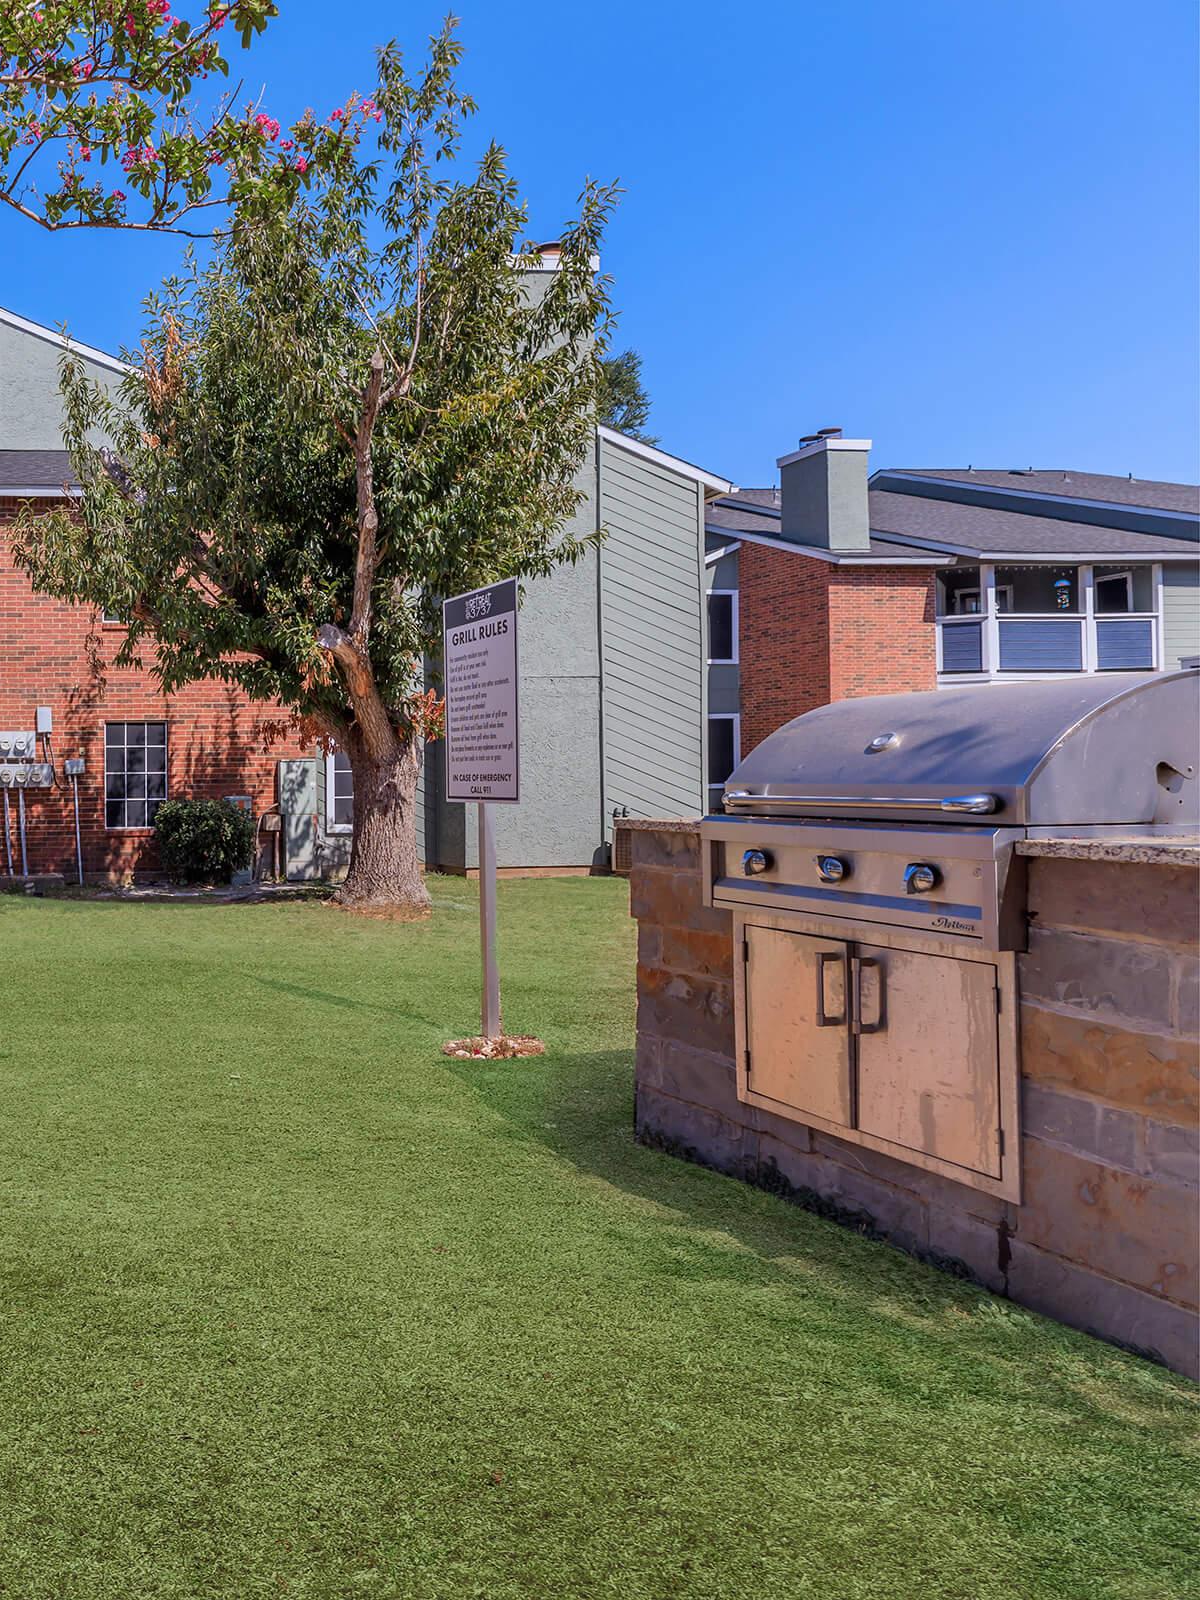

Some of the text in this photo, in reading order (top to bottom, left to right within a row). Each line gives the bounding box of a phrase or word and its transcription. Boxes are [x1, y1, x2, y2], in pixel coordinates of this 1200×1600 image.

[469, 602, 492, 619] 3737
[452, 619, 508, 647] GRILL RULES
[452, 773, 512, 782] IN CASE OF EMERGENCY
[470, 785, 492, 794] CALL 911
